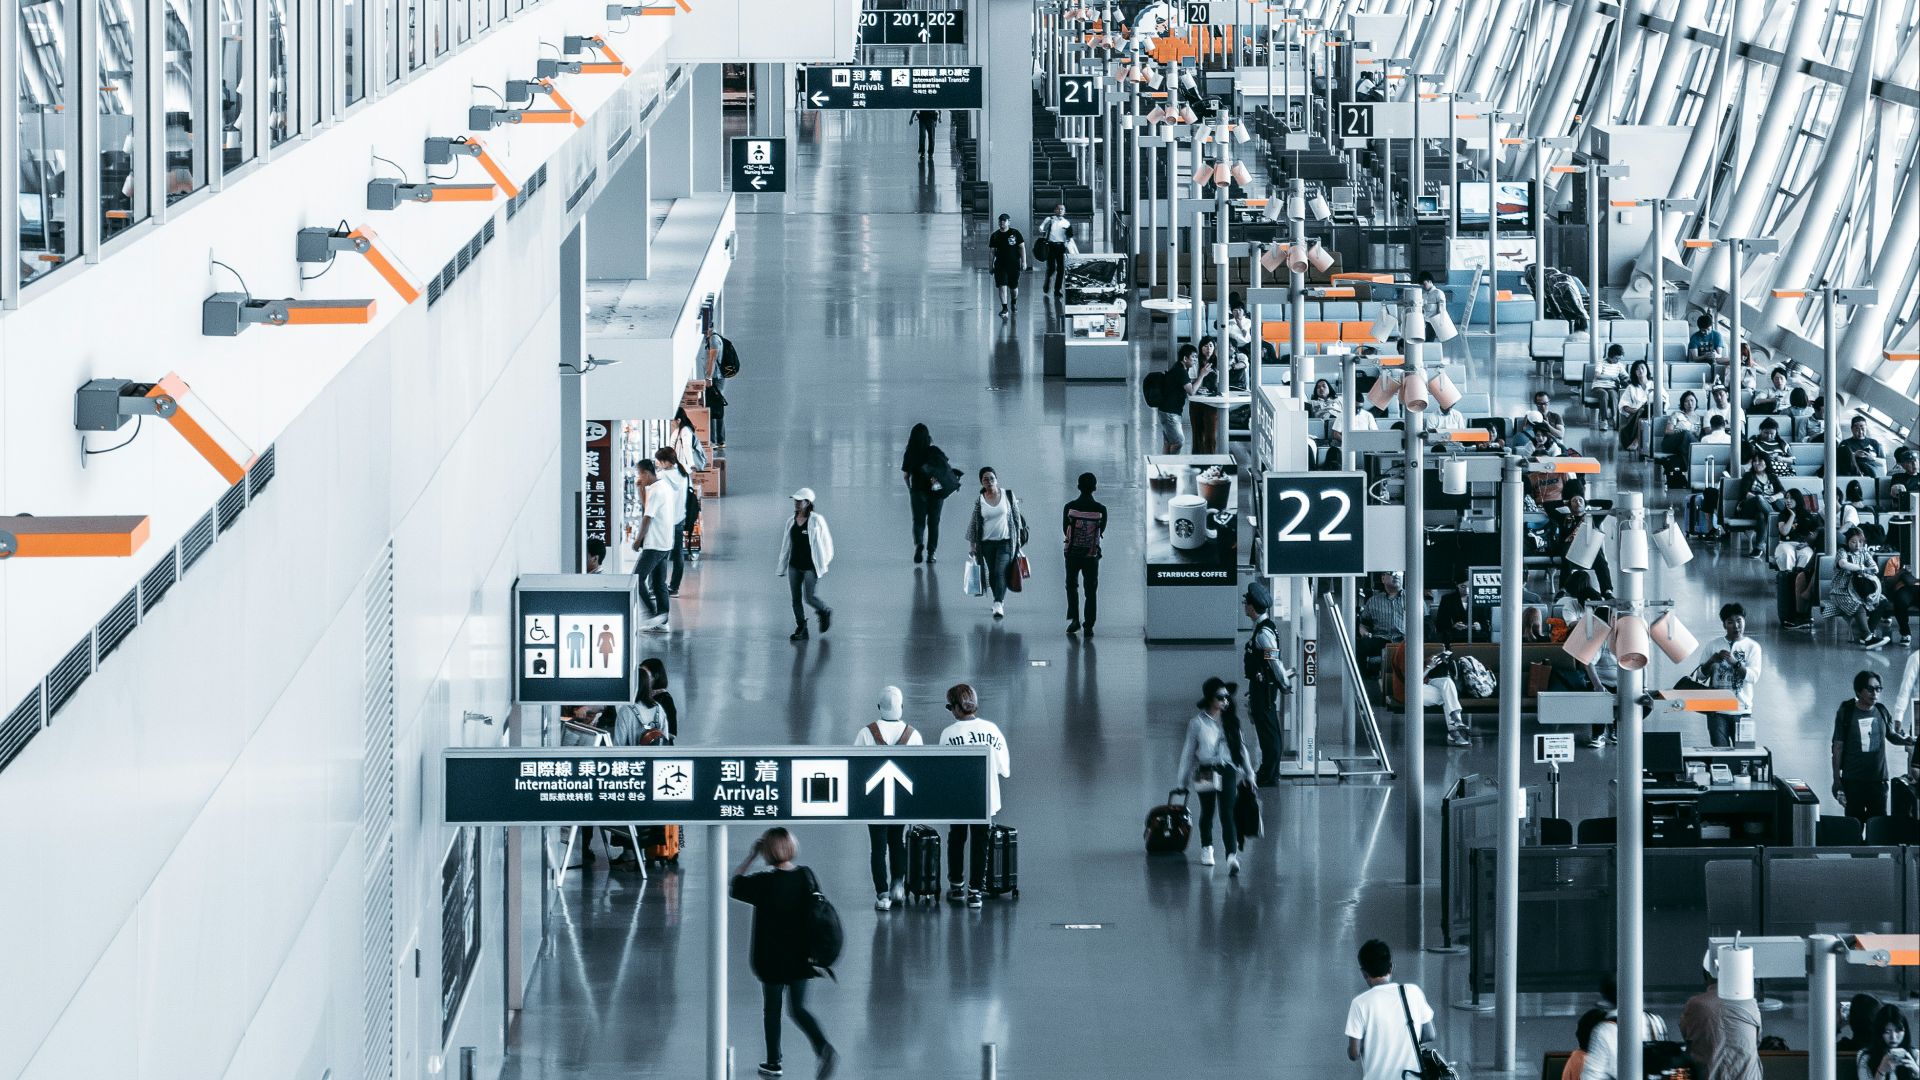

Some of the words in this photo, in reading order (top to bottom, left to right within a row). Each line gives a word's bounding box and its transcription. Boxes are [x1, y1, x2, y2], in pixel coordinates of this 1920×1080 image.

[892, 13, 924, 27] 201,
[928, 13, 955, 26] 202
[1191, 5, 1206, 22] 20
[853, 83, 884, 91] Arrivals
[1064, 81, 1093, 103] 21
[1347, 108, 1368, 134] 21
[1278, 489, 1352, 542] 22
[1306, 654, 1315, 685] AED
[520, 761, 573, 777] 国際線
[578, 761, 646, 777] 乗り継ぎ
[720, 759, 779, 782] 到着
[514, 778, 593, 791] International
[596, 778, 646, 791] Transfer
[713, 784, 779, 801] Arrivals
[719, 805, 745, 817] 到达
[753, 805, 779, 817] 도착
